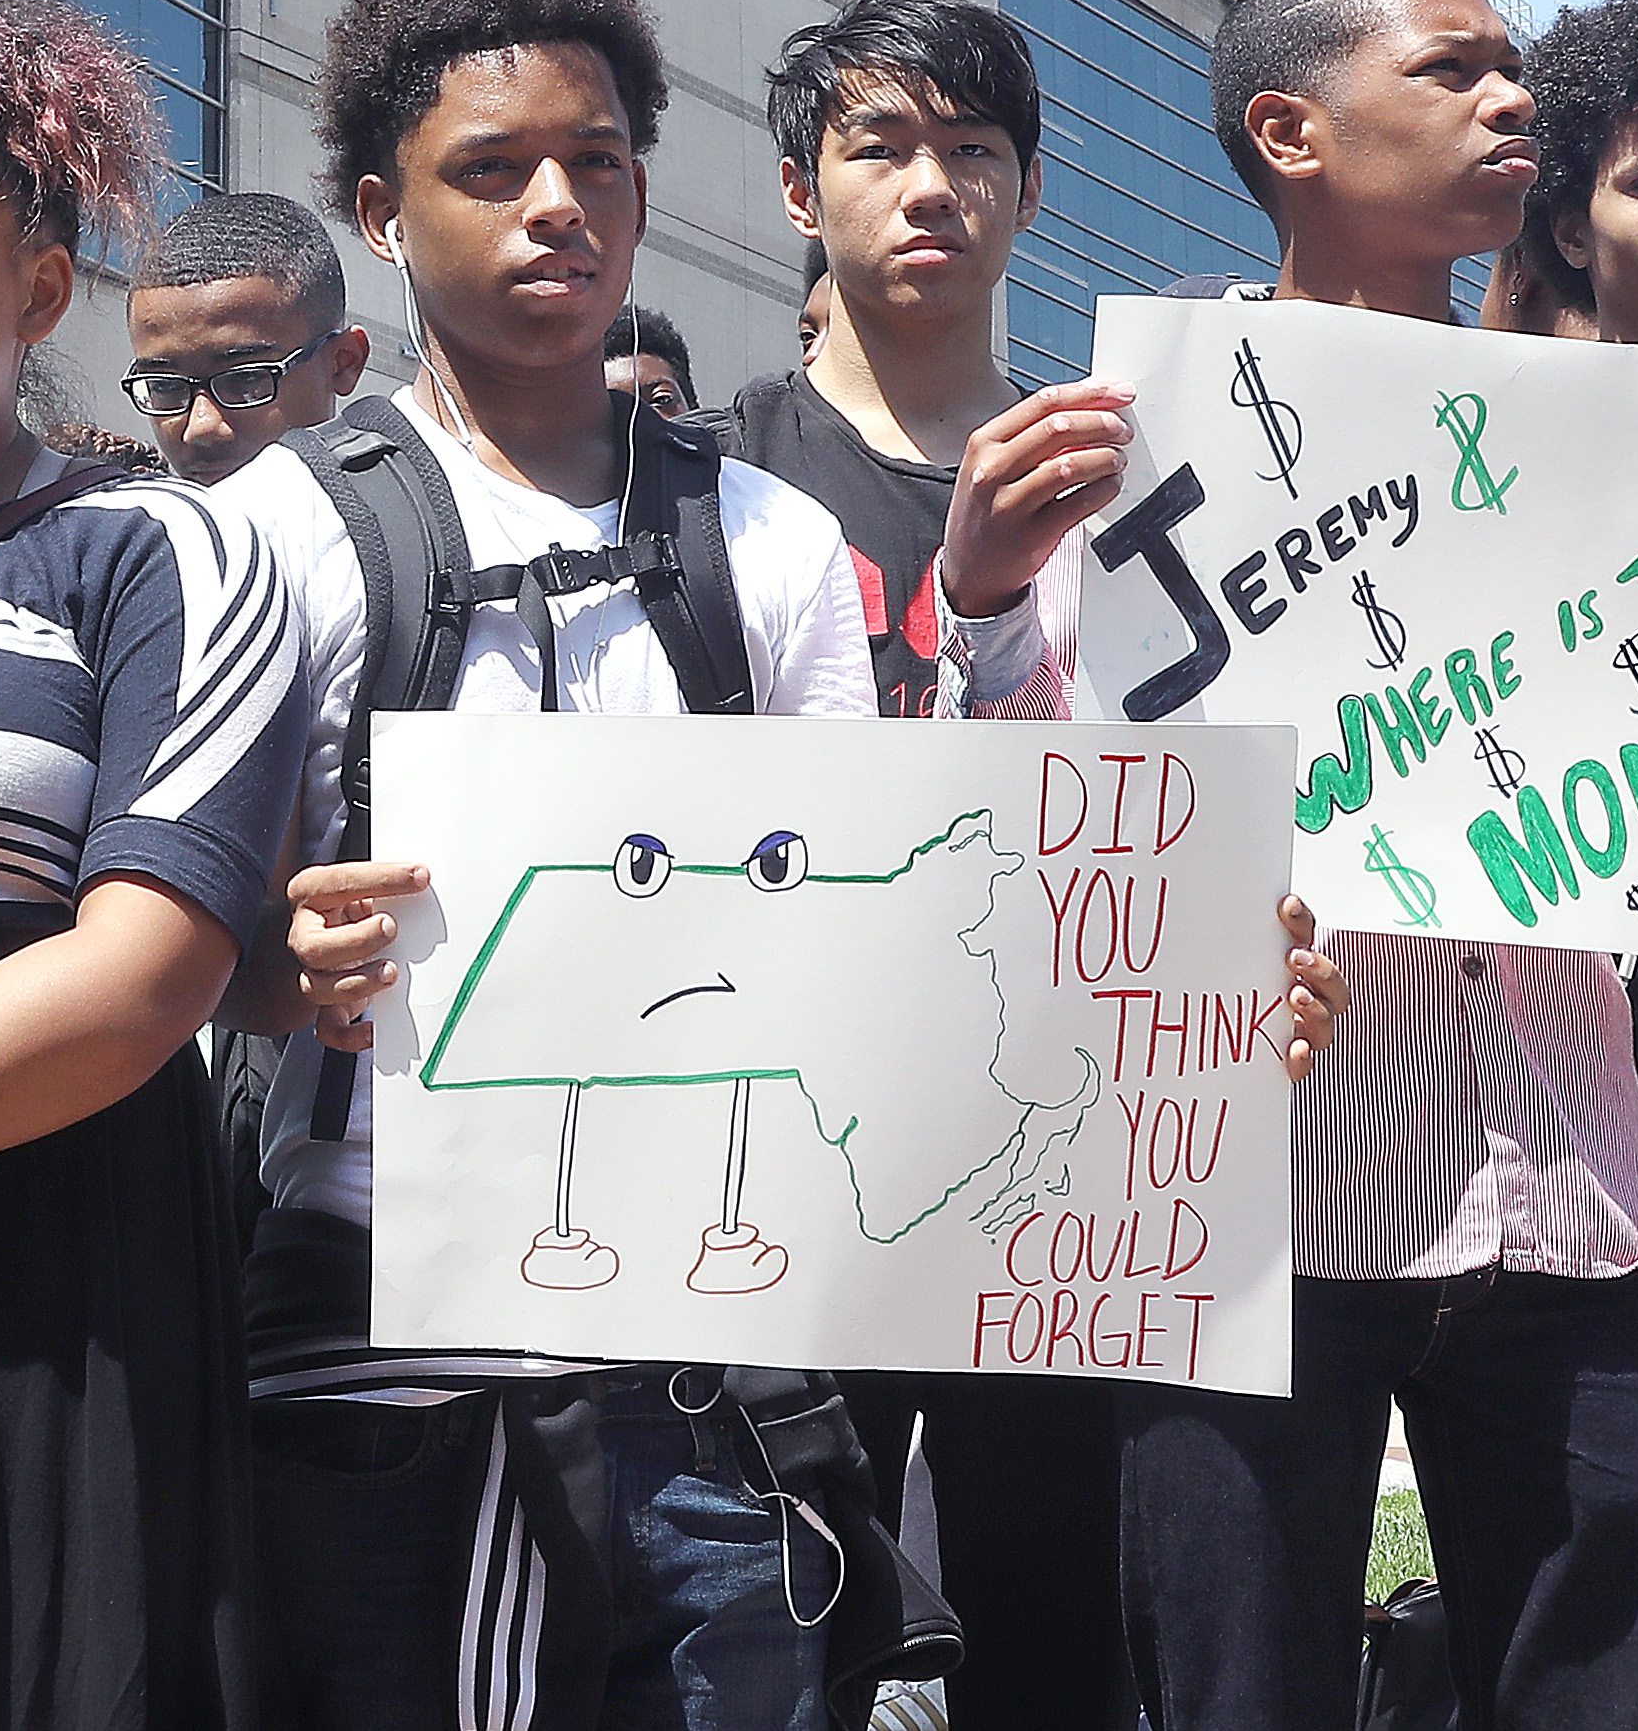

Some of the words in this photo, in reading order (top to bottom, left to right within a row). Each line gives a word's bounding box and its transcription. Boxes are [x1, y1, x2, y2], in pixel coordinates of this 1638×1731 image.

[1090, 461, 1419, 722] JEREMY
[1294, 630, 1523, 834] WHERE
[1558, 589, 1604, 653] IS
[1037, 751, 1197, 856] DID
[1036, 866, 1169, 988] YOU
[1090, 988, 1285, 1083] THINK
[1115, 1089, 1230, 1201] YOU
[1005, 1198, 1210, 1287] COULD
[972, 1288, 1215, 1381] FORGET
